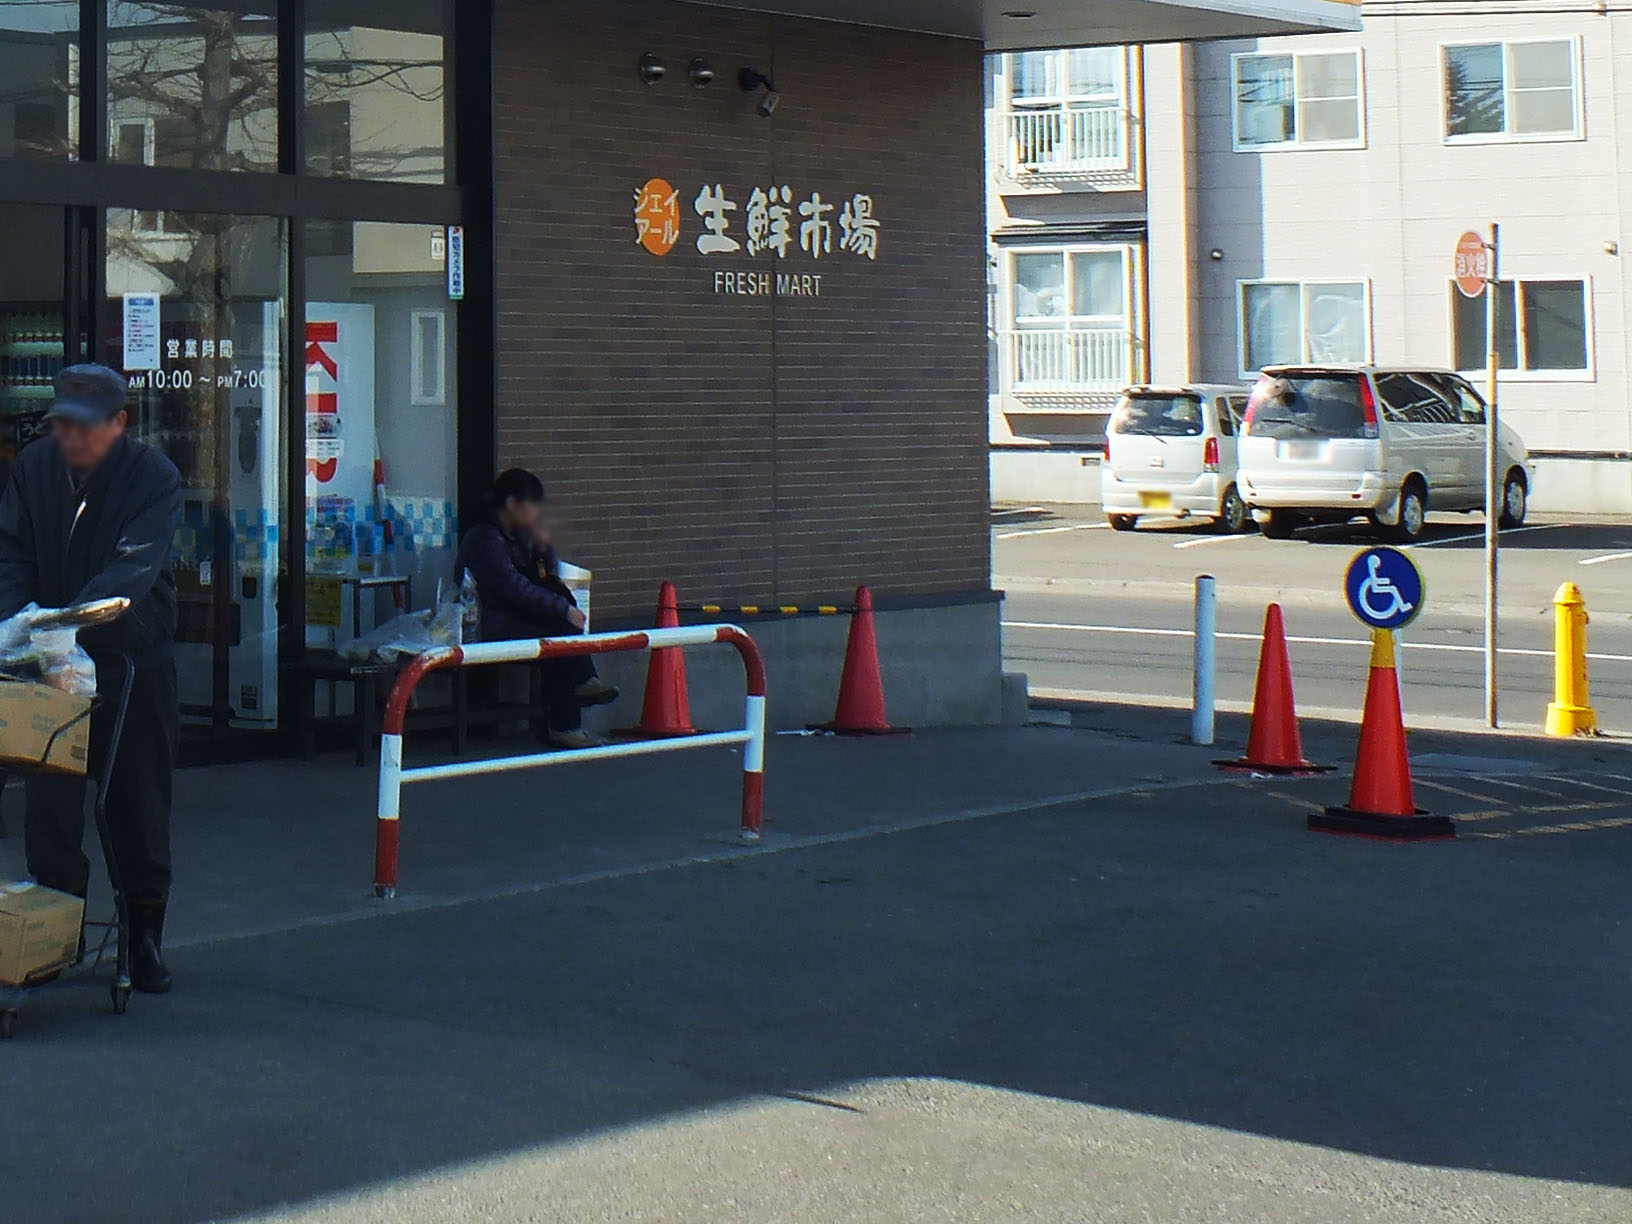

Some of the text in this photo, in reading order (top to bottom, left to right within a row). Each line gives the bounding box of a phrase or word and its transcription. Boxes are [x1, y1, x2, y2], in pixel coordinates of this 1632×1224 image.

[694, 183, 881, 261] 生鮮市場
[713, 271, 821, 296] FRESH MART
[166, 339, 233, 359] 営業時間
